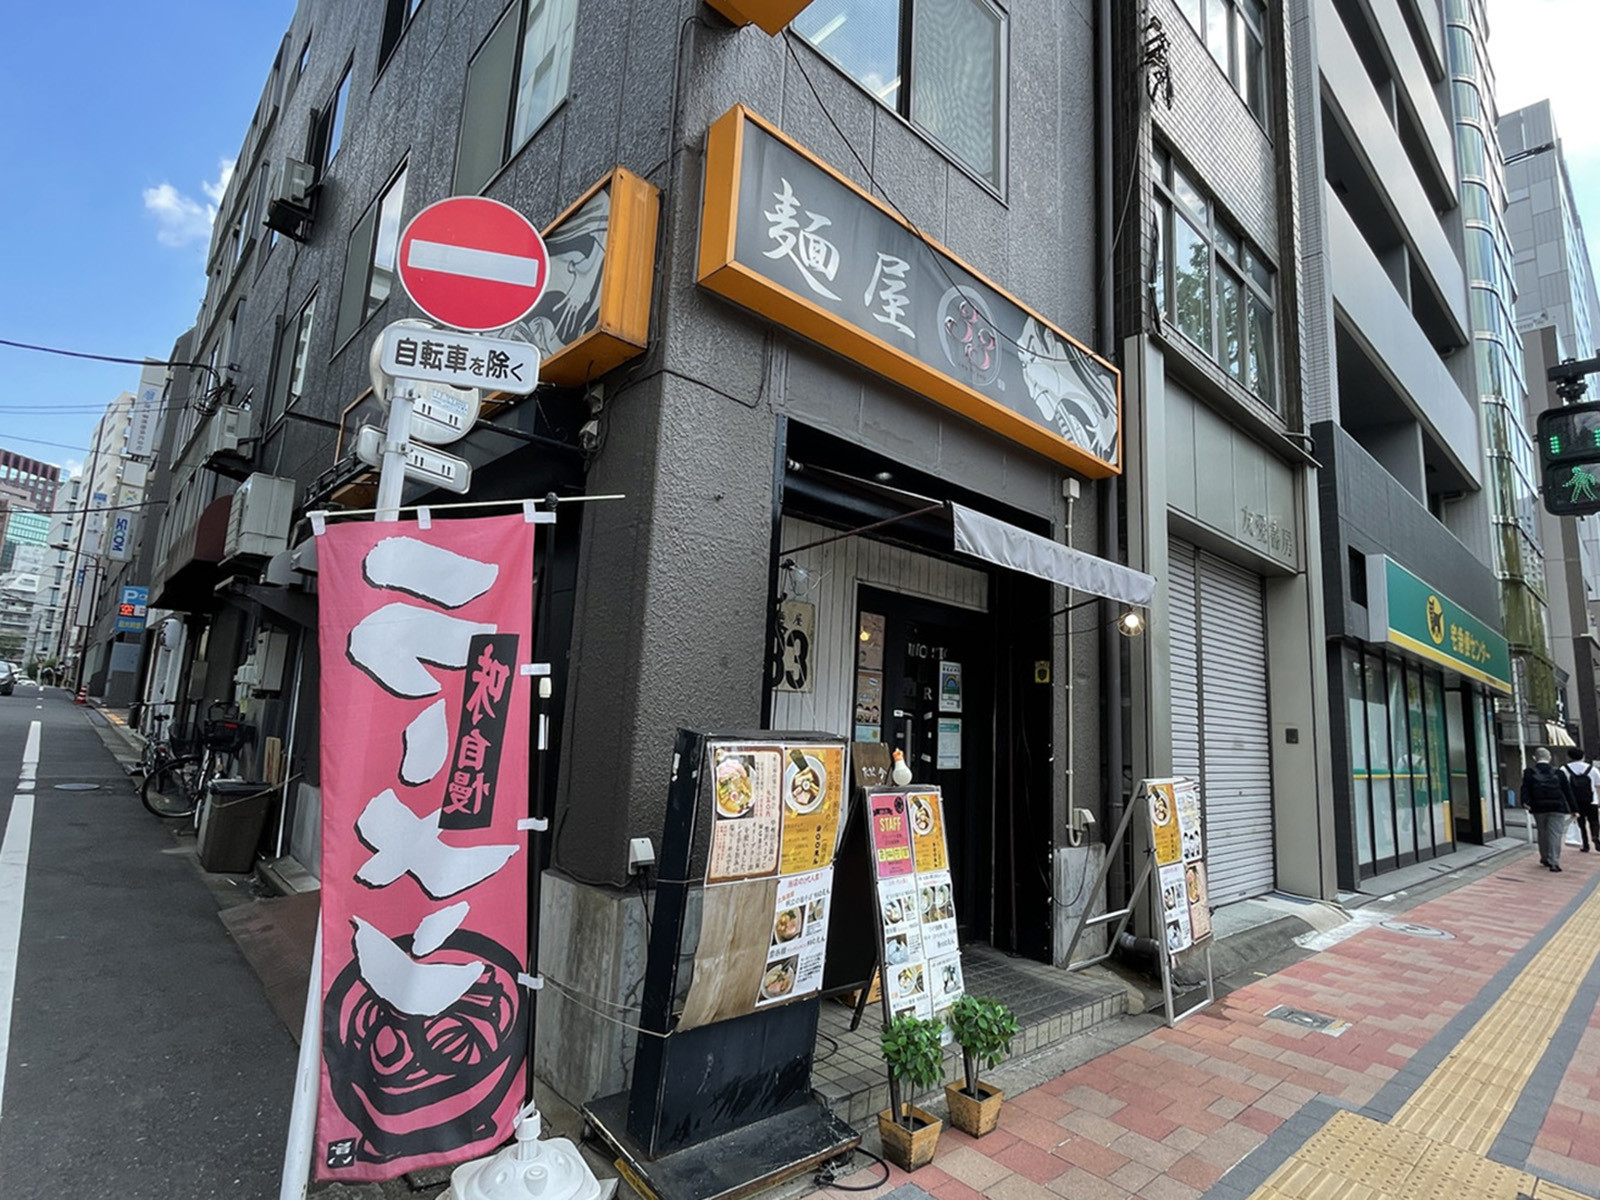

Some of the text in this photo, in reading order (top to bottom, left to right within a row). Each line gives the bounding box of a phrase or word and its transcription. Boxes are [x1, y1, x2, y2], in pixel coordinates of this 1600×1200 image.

[763, 177, 916, 339] 麺屋
[395, 338, 524, 382] 自転車を除く
[112, 518, 128, 552] SECOM
[124, 590, 138, 602] P
[1450, 623, 1491, 664] 宅急便センター
[880, 816, 901, 833] STAFF
